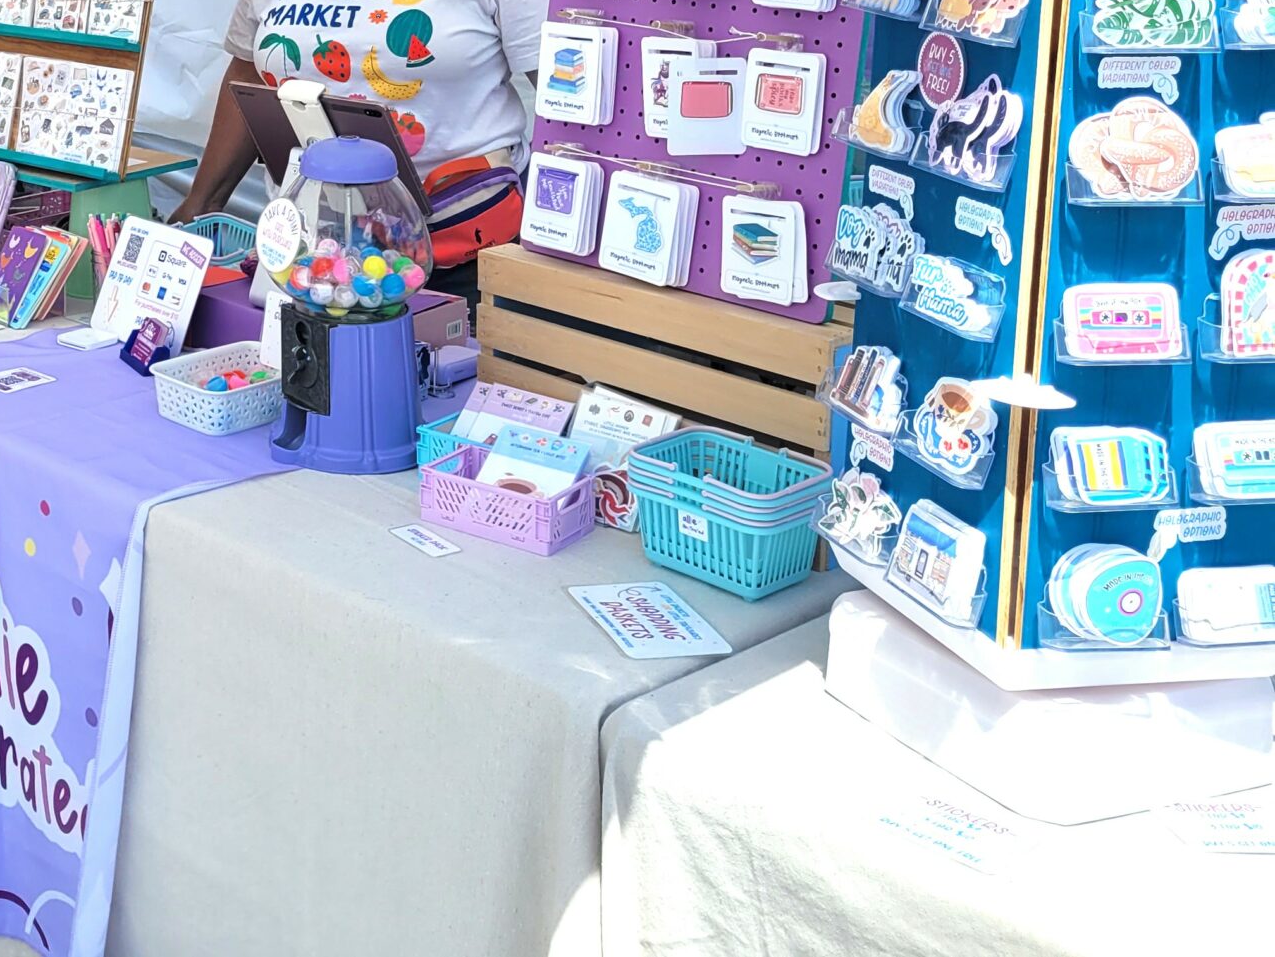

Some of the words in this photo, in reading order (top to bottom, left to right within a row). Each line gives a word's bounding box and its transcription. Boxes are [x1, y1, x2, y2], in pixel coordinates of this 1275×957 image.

[264, 3, 361, 29] MARKET
[928, 43, 947, 63] BUY
[947, 50, 956, 64] 5
[1102, 60, 1147, 71] DIFFERENT
[1148, 60, 1177, 70] COLOR
[925, 73, 951, 95] FREE!
[1102, 73, 1150, 84] VARIATIONS
[871, 168, 898, 185] DIFFERENT
[897, 177, 913, 190] COLOR
[871, 180, 900, 197] VARIATIONS
[264, 204, 280, 222] TAKE
[281, 205, 287, 217] A
[957, 213, 985, 232] OPTIONS
[838, 208, 866, 249] Dog
[166, 254, 187, 268] Square
[834, 247, 869, 274] mama
[915, 256, 944, 282] Fur
[919, 287, 965, 322] Mama
[854, 427, 892, 454] HOLOGRAPHIC
[869, 447, 892, 468] OPTIONS
[1157, 511, 1222, 527] HOLOGRAPHIC
[1183, 525, 1222, 538] OPTIONS
[1103, 575, 1122, 592] MADE
[599, 601, 654, 640] BASKETS
[626, 596, 687, 641] SHOPPING
